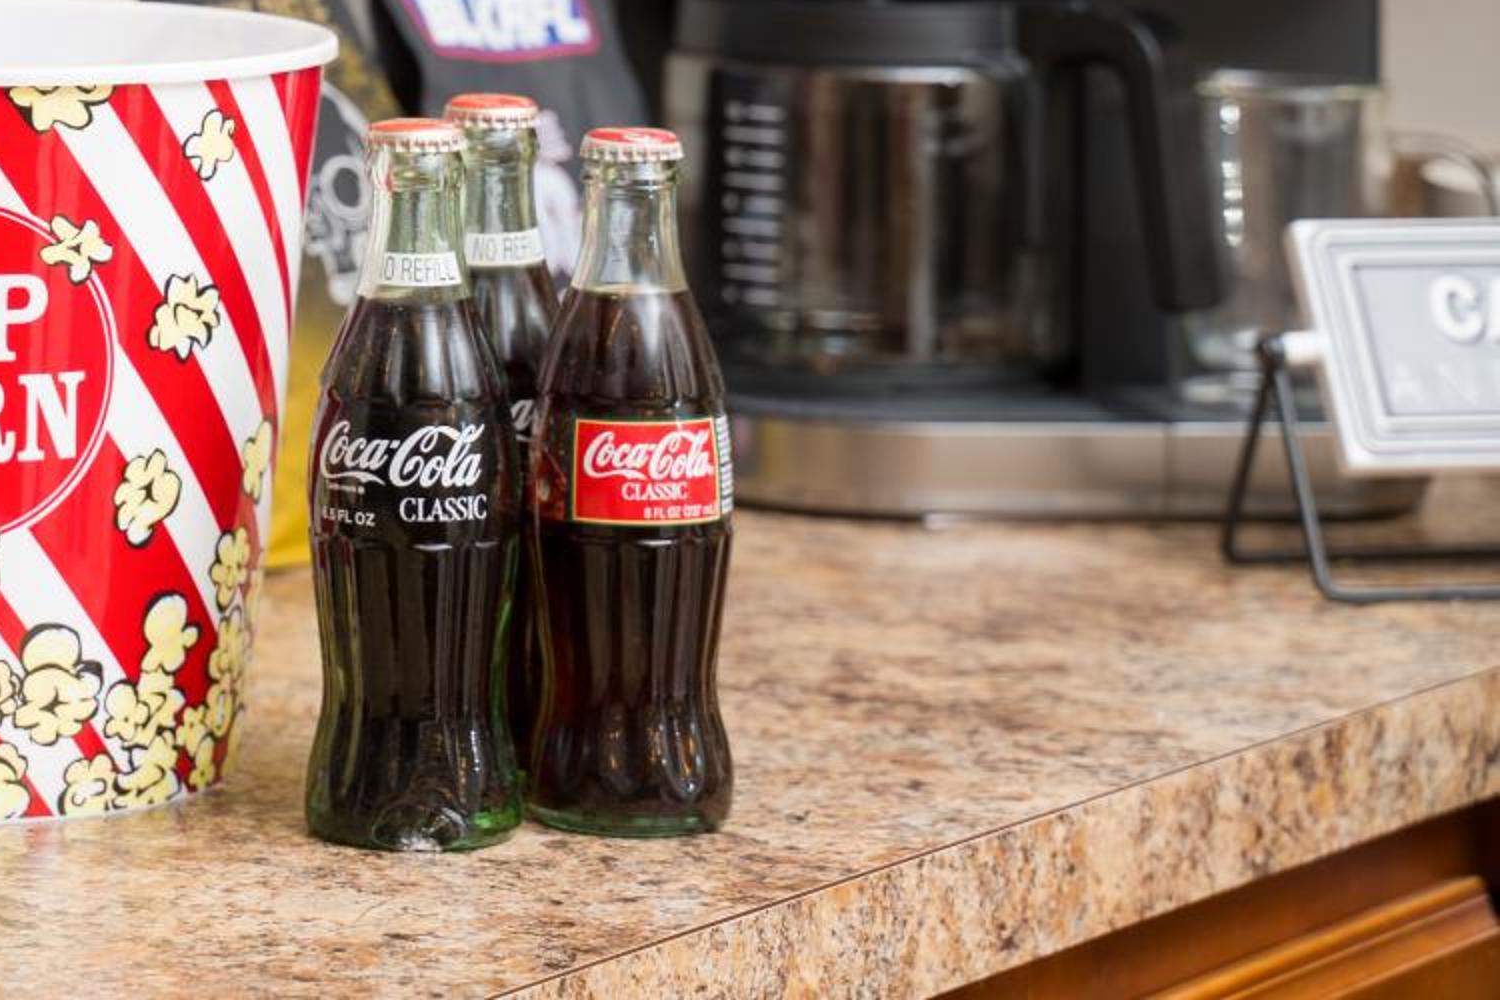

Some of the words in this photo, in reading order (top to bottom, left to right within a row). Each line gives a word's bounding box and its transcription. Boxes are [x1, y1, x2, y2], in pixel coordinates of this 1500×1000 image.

[320, 419, 485, 488] Coca-Cola
[583, 430, 714, 481] Coca-Cola
[621, 481, 689, 501] CLASSIC
[337, 509, 353, 524] FL
[354, 511, 377, 527] OZ
[399, 494, 487, 523] CLASSIC
